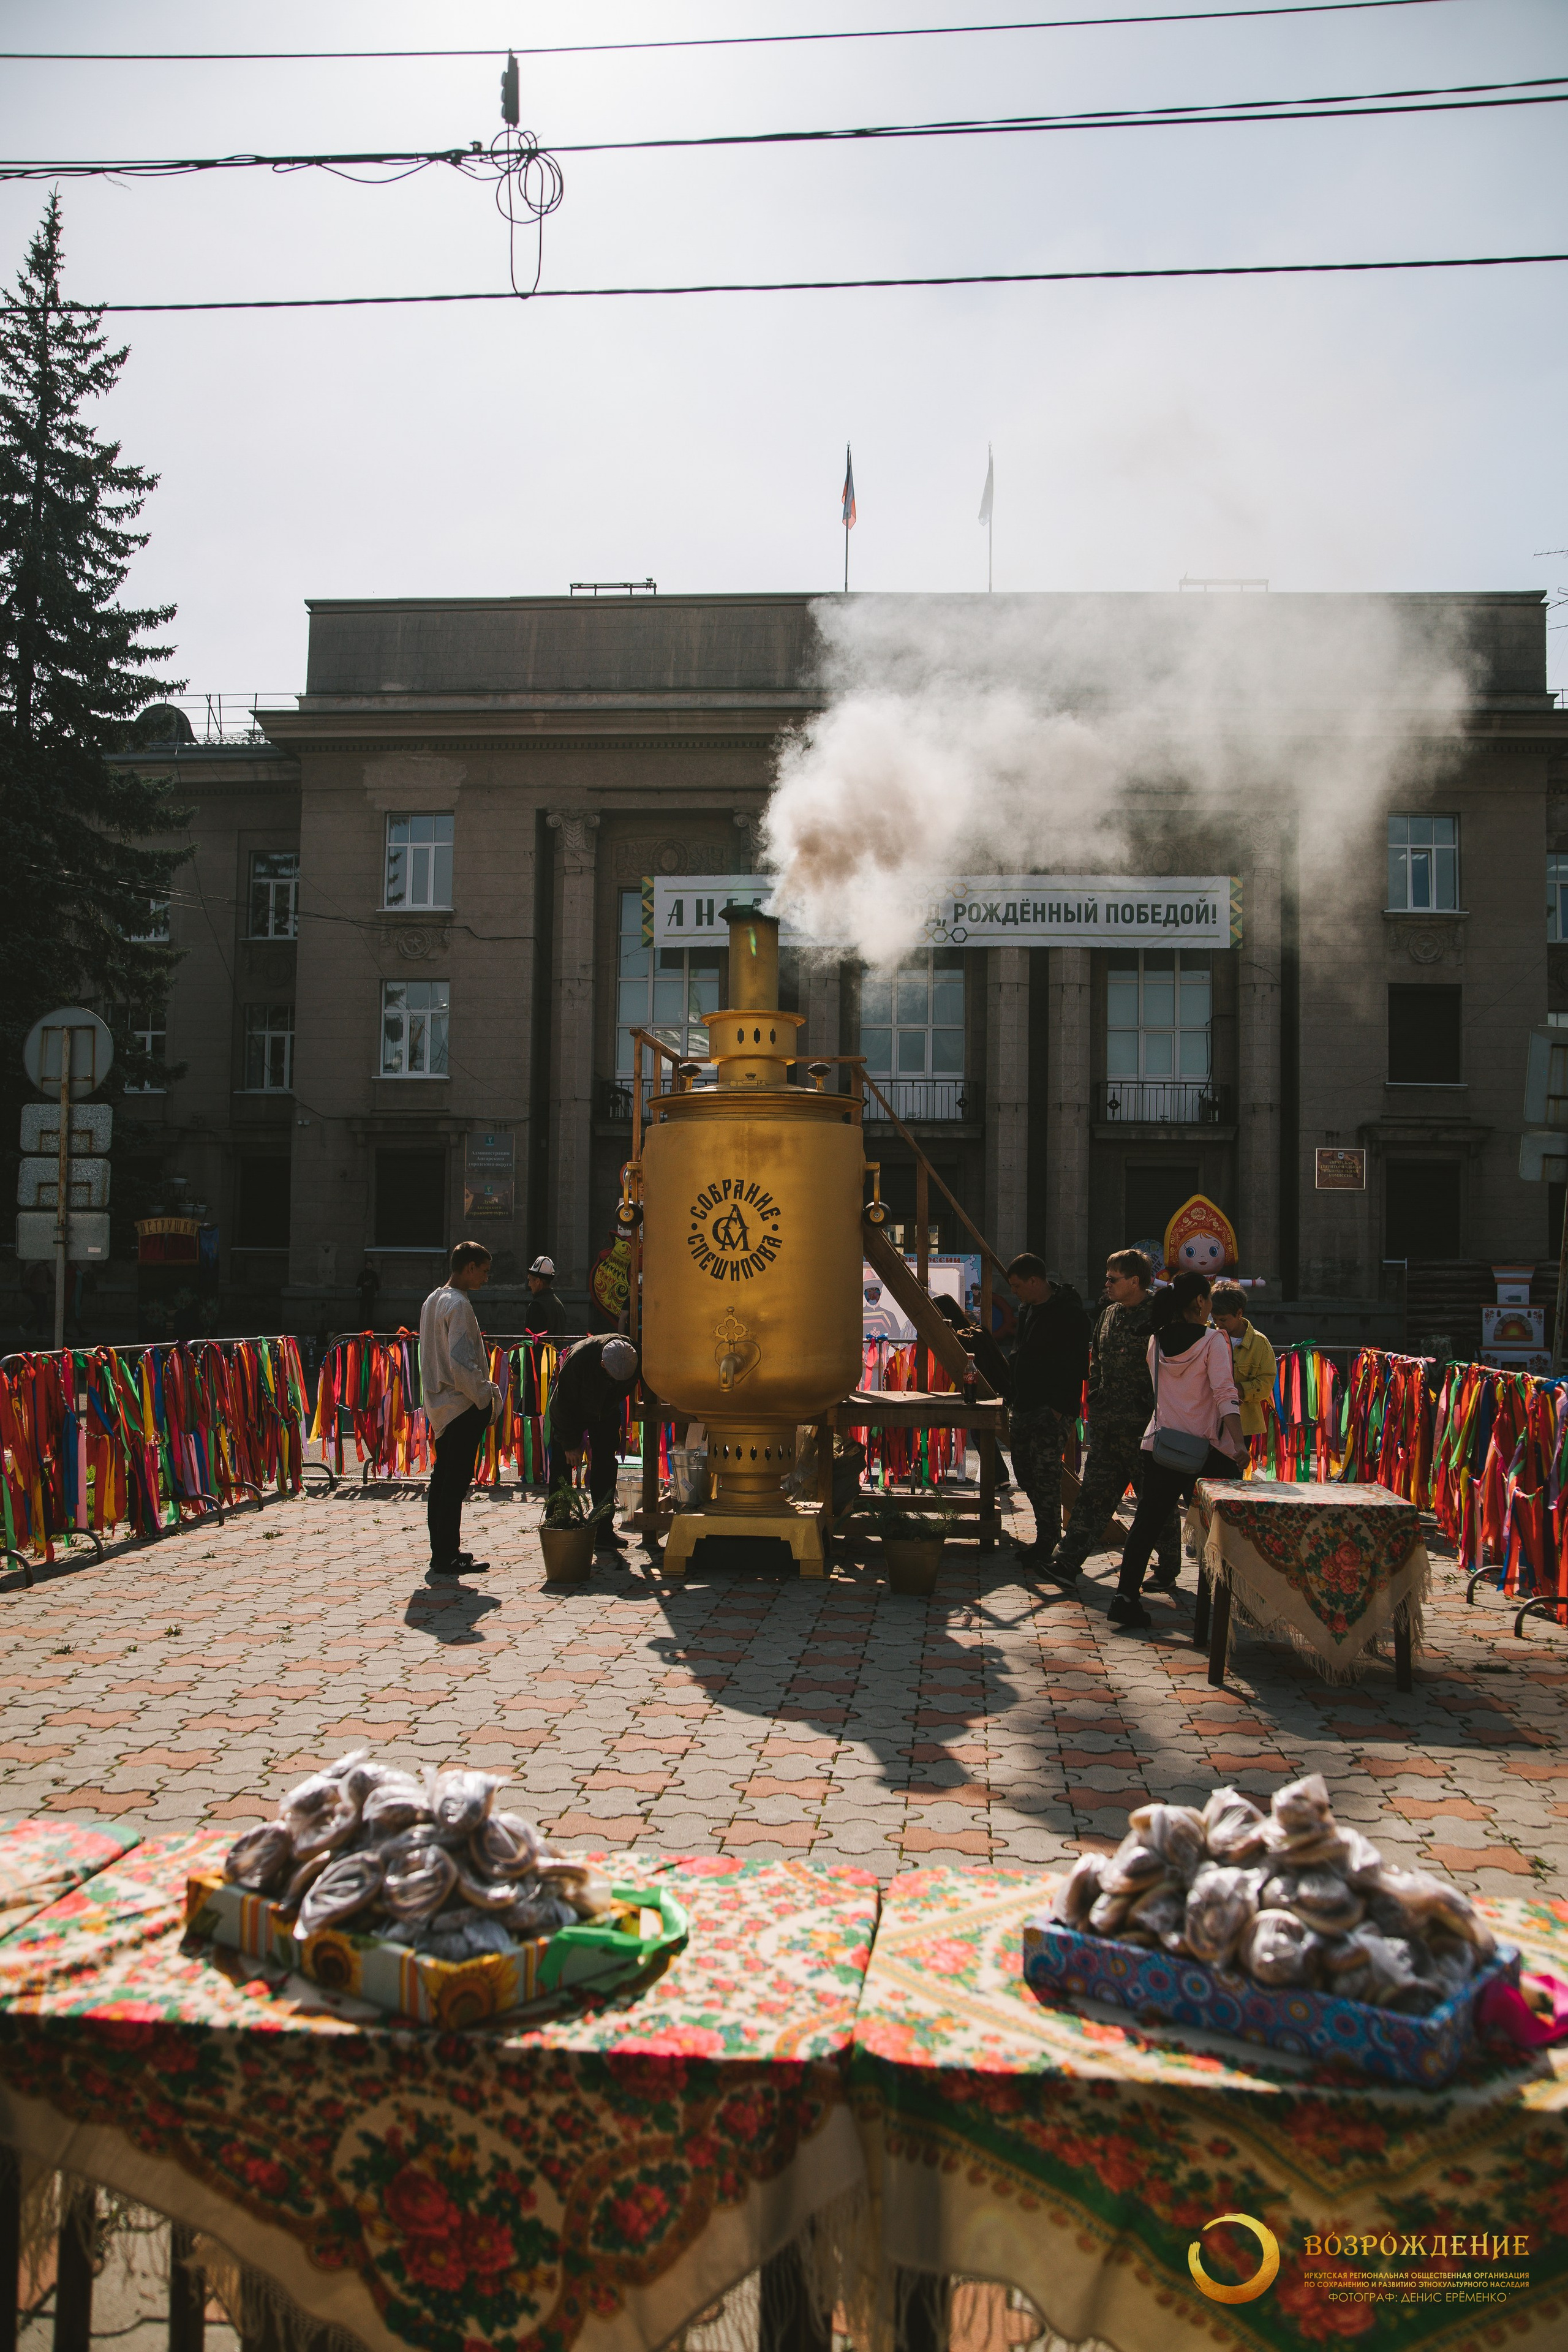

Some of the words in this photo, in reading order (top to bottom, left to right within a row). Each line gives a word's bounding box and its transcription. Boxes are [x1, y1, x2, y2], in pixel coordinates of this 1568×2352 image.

[954, 897, 1098, 925] РОЖДЁННЫЙ
[1106, 898, 1218, 927] ПОБЕДОЙ!
[690, 1178, 782, 1222] СОБРАНИЕ
[140, 1219, 195, 1234] ПЕТРУШКА
